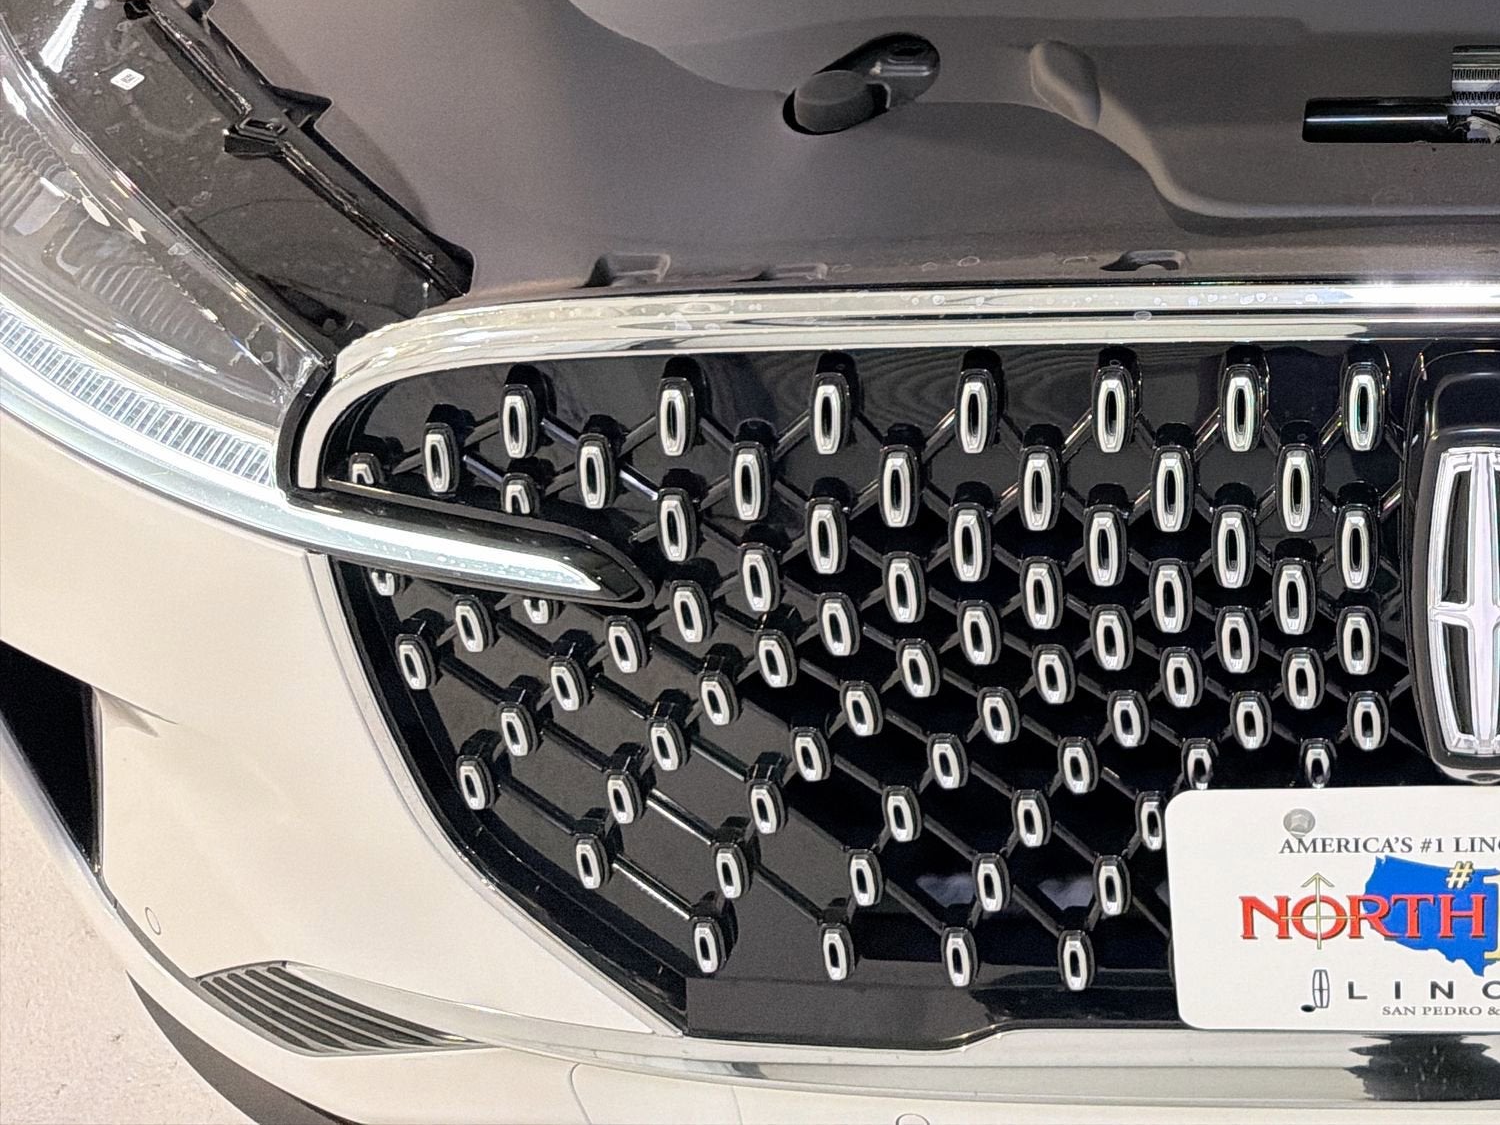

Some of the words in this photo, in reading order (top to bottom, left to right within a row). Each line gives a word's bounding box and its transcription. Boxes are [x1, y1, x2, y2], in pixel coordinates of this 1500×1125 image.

[1278, 836, 1413, 854] AMERICA'S
[1419, 837, 1444, 853] #1
[1238, 893, 1488, 940] NORTH
[1382, 1005, 1418, 1017] SAN
[1422, 1005, 1483, 1017] PEDRO
